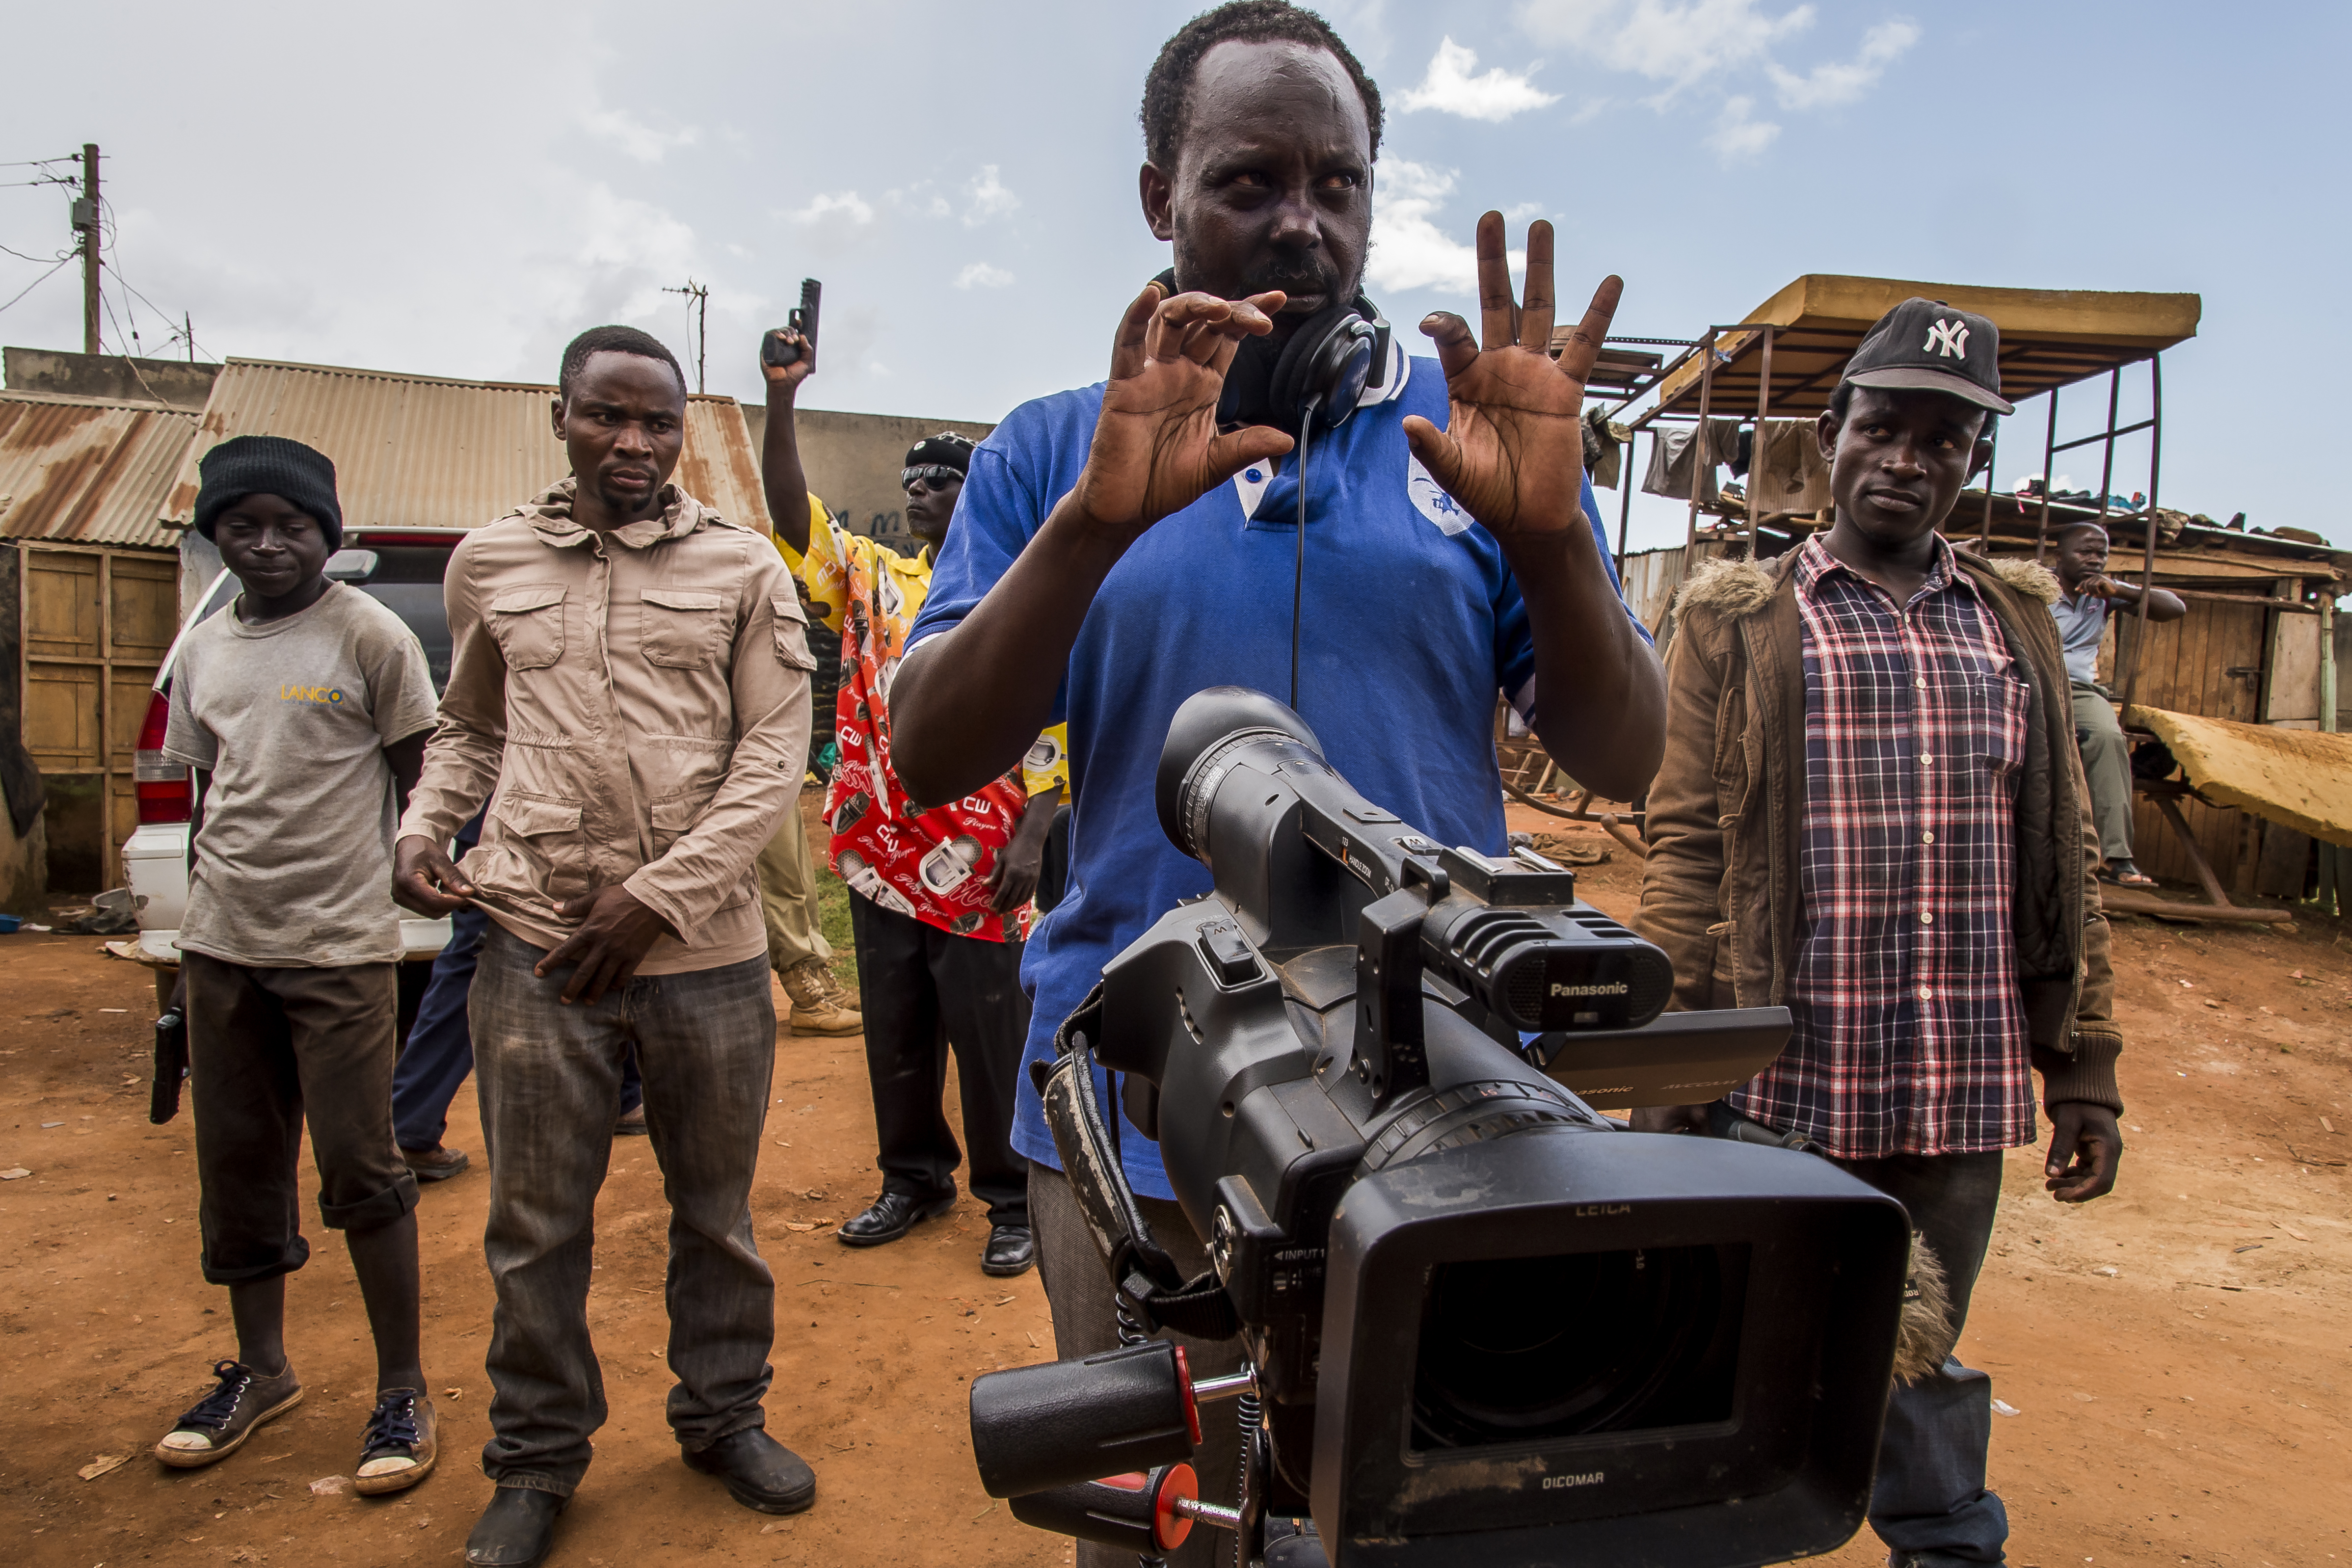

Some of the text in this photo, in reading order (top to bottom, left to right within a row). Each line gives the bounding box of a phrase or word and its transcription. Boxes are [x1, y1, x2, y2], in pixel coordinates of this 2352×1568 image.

[842, 760, 870, 774] Play
[963, 796, 991, 814] CW
[962, 816, 997, 830] Players
[1349, 855, 1371, 878] HANDLE ZOOM
[894, 873, 934, 904] Players
[1551, 981, 1629, 999] Panasonic
[1573, 1086, 1633, 1095] asonic
[1576, 1204, 1630, 1216] LEICA
[1285, 1249, 1324, 1259] INPUT 1
[1543, 1472, 1604, 1489] DICOMAR
